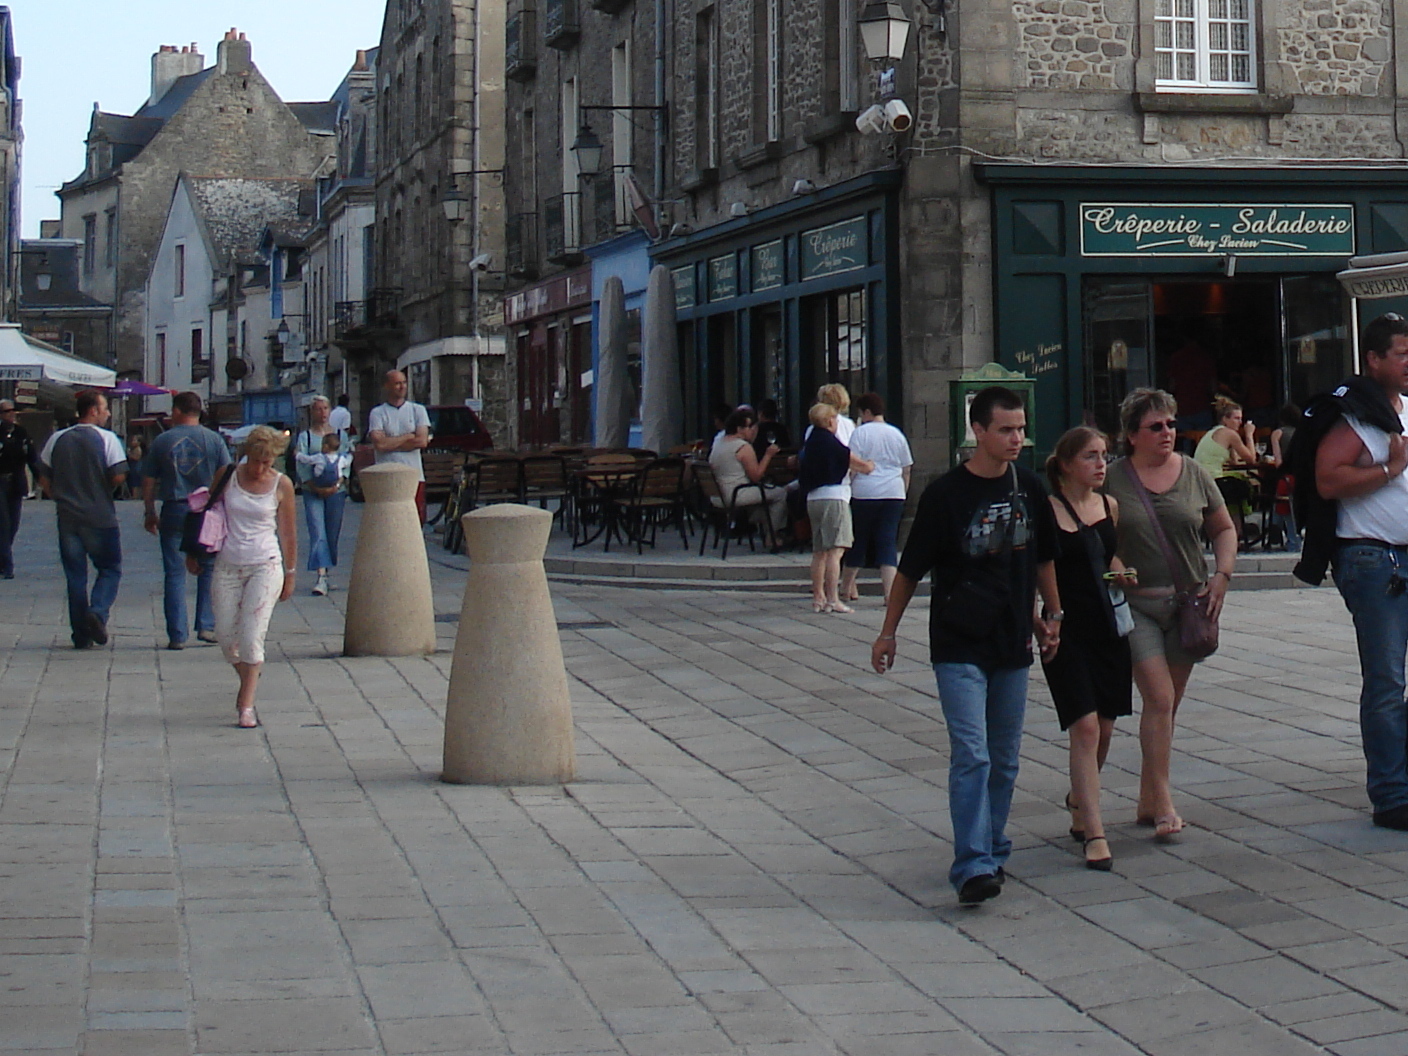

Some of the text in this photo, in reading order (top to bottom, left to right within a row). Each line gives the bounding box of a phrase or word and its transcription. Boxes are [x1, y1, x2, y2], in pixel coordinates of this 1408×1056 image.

[1084, 207, 1202, 242] Crêperie
[1231, 208, 1352, 234] Saladerie
[809, 231, 858, 256] Crêperie
[1188, 234, 1260, 252] Chez Lucien
